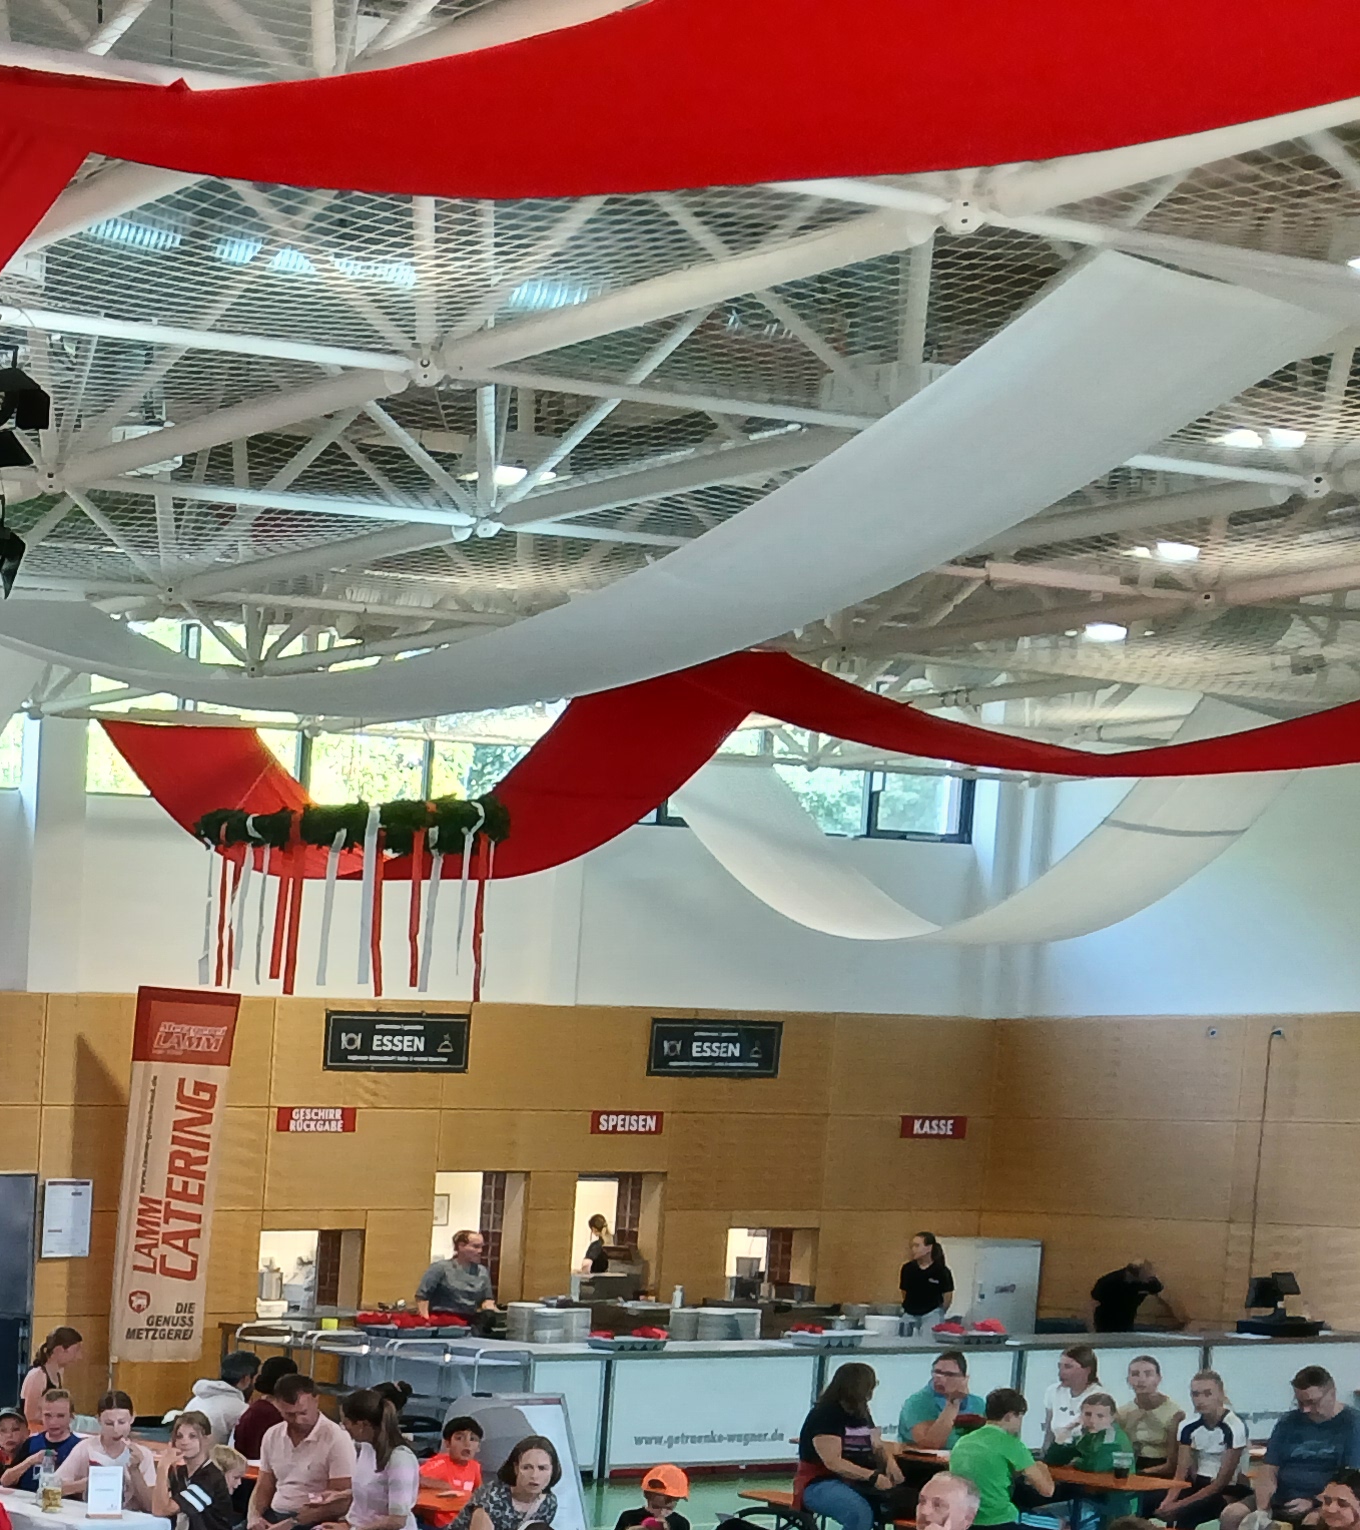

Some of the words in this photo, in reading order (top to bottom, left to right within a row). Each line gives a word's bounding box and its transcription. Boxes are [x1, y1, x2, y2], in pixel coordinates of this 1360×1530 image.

[153, 1032, 224, 1052] LAMM
[372, 1035, 425, 1052] ESSEN
[691, 1042, 741, 1057] ESSEN
[292, 1109, 342, 1120] GESCHIRR
[289, 1120, 344, 1132] RÜCKGABE
[599, 1115, 657, 1132] SPEISEN
[913, 1119, 954, 1135] KASSE
[159, 1077, 218, 1281] CATERING
[133, 1196, 163, 1275] LAMM
[175, 1303, 196, 1315] DIE
[146, 1315, 195, 1327] GENUSS
[126, 1328, 194, 1340] METZGEREI
[634, 1428, 784, 1448] www.getraenke-wagner.de
